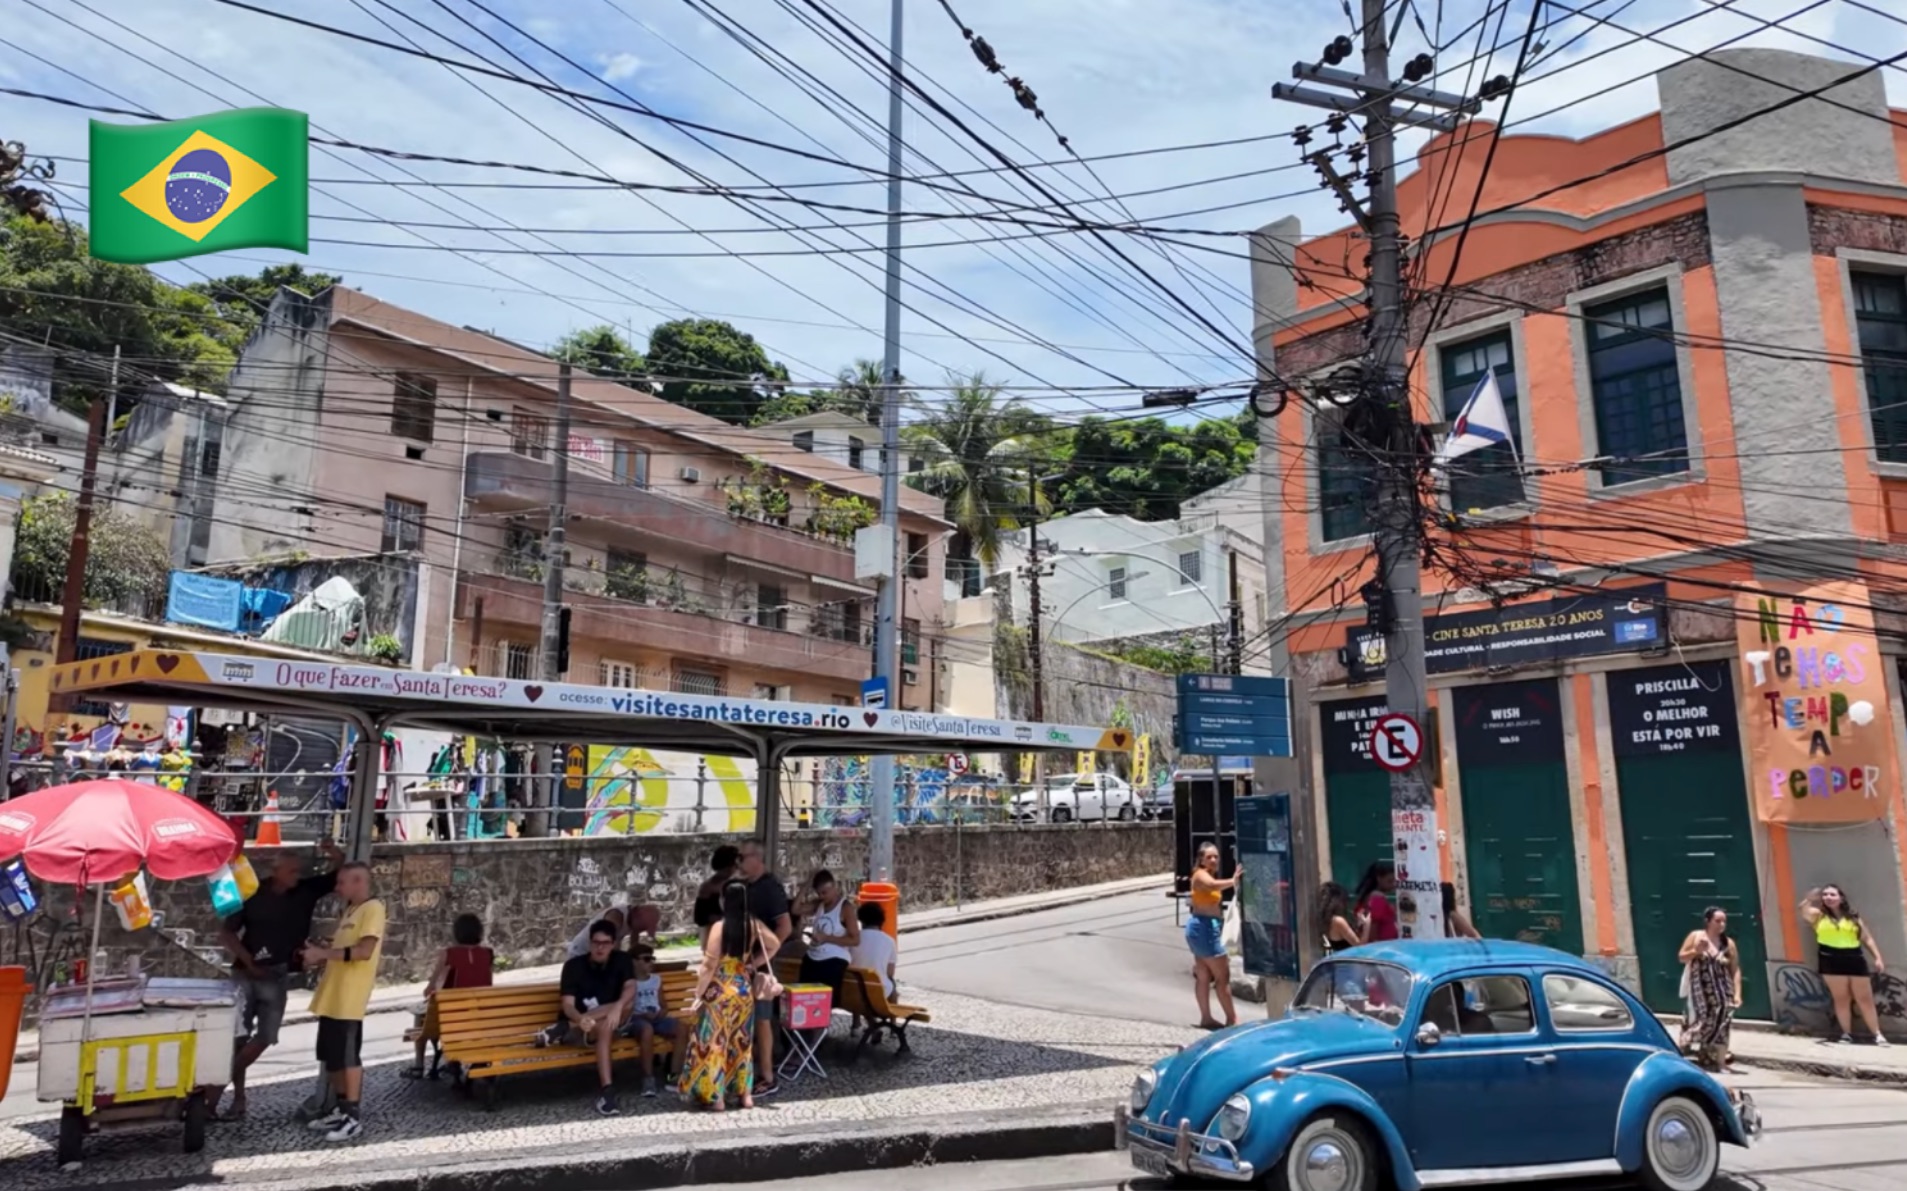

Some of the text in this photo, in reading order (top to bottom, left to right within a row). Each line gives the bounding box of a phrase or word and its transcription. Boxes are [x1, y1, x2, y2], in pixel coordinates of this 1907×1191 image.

[1432, 629, 1459, 642] CINE
[1462, 624, 1499, 638] SANTA
[1502, 618, 1547, 633] TERESA
[1549, 614, 1566, 627] 20
[1568, 608, 1604, 625] ANOS
[1757, 596, 1844, 643] NÃO
[1424, 648, 1444, 658] DADE
[1445, 643, 1485, 656] CULTURAL
[1490, 633, 1573, 650] RESPONSABILIDADE
[1574, 628, 1606, 640] SOCIAL
[275, 662, 291, 687] O
[294, 670, 326, 689] que
[392, 673, 441, 696] Santa
[441, 676, 508, 699] Teresa?
[1635, 677, 1700, 695] PRISCILLA
[559, 690, 851, 729] acesse: visitesantateresa.rio
[1369, 705, 1389, 718] IRM
[1490, 707, 1520, 720] WISH
[1642, 705, 1709, 722] O MELHOR
[1354, 721, 1360, 732] E
[1632, 723, 1721, 743] ESTÁ POR VIR
[1350, 740, 1371, 752] PAT
[1808, 729, 1832, 757] A
